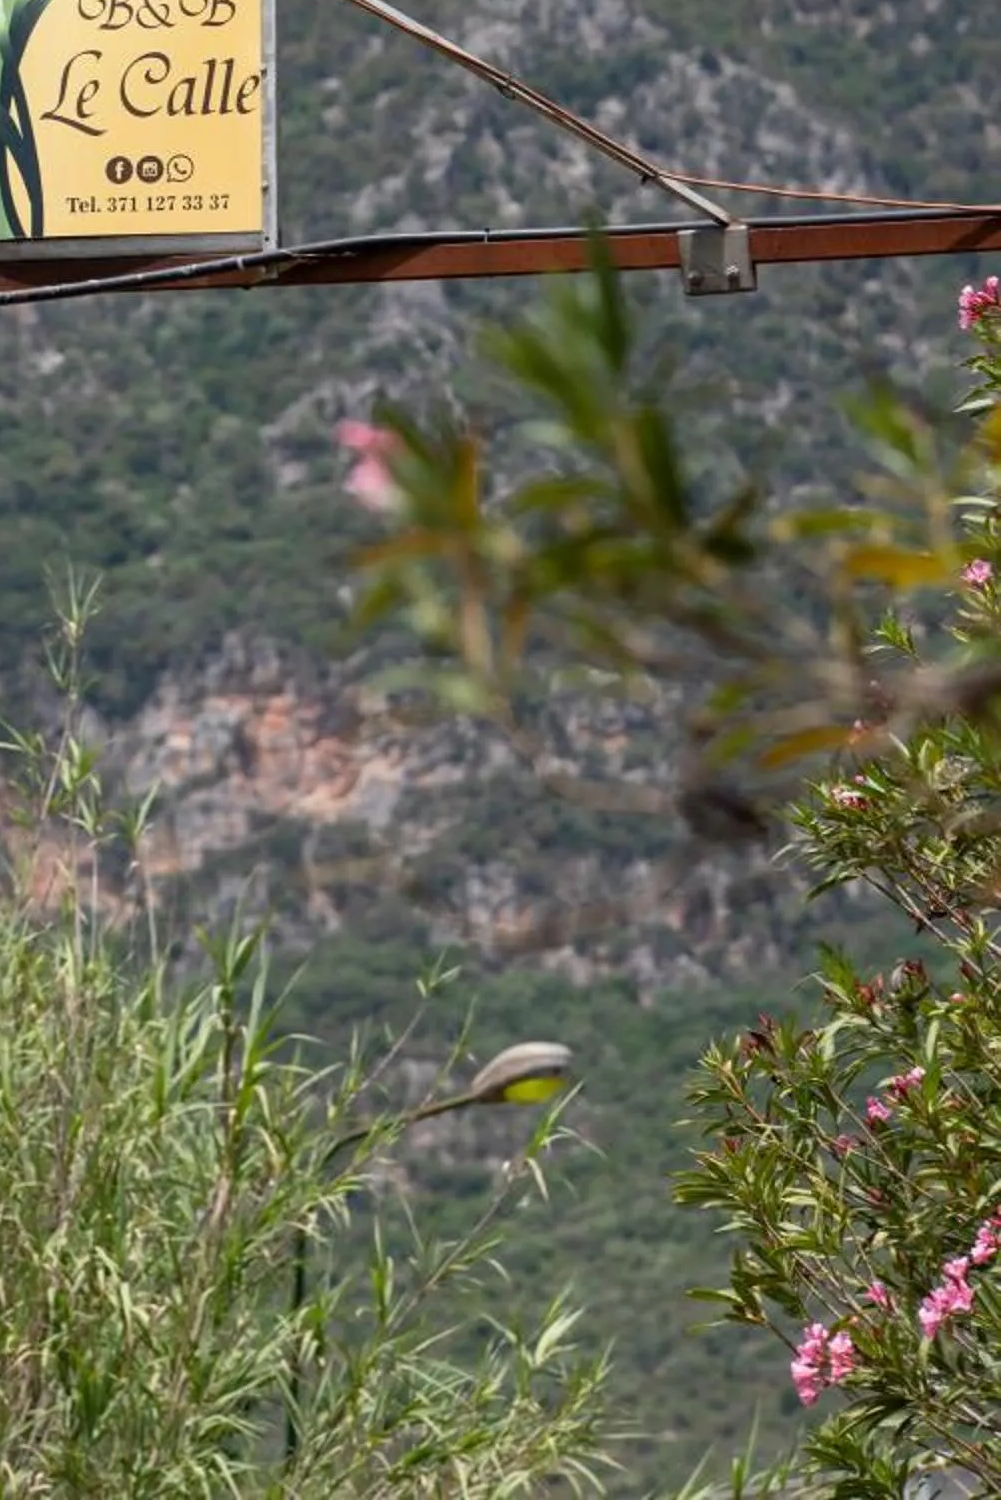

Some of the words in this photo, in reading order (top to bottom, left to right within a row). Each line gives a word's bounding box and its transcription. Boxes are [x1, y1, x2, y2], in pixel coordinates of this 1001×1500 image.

[40, 49, 108, 136] Le
[120, 51, 261, 118] Calle
[66, 196, 101, 213] Tel.
[107, 197, 138, 213] 371
[146, 196, 176, 212] 127
[182, 195, 204, 211] 33
[209, 194, 230, 210] 37
